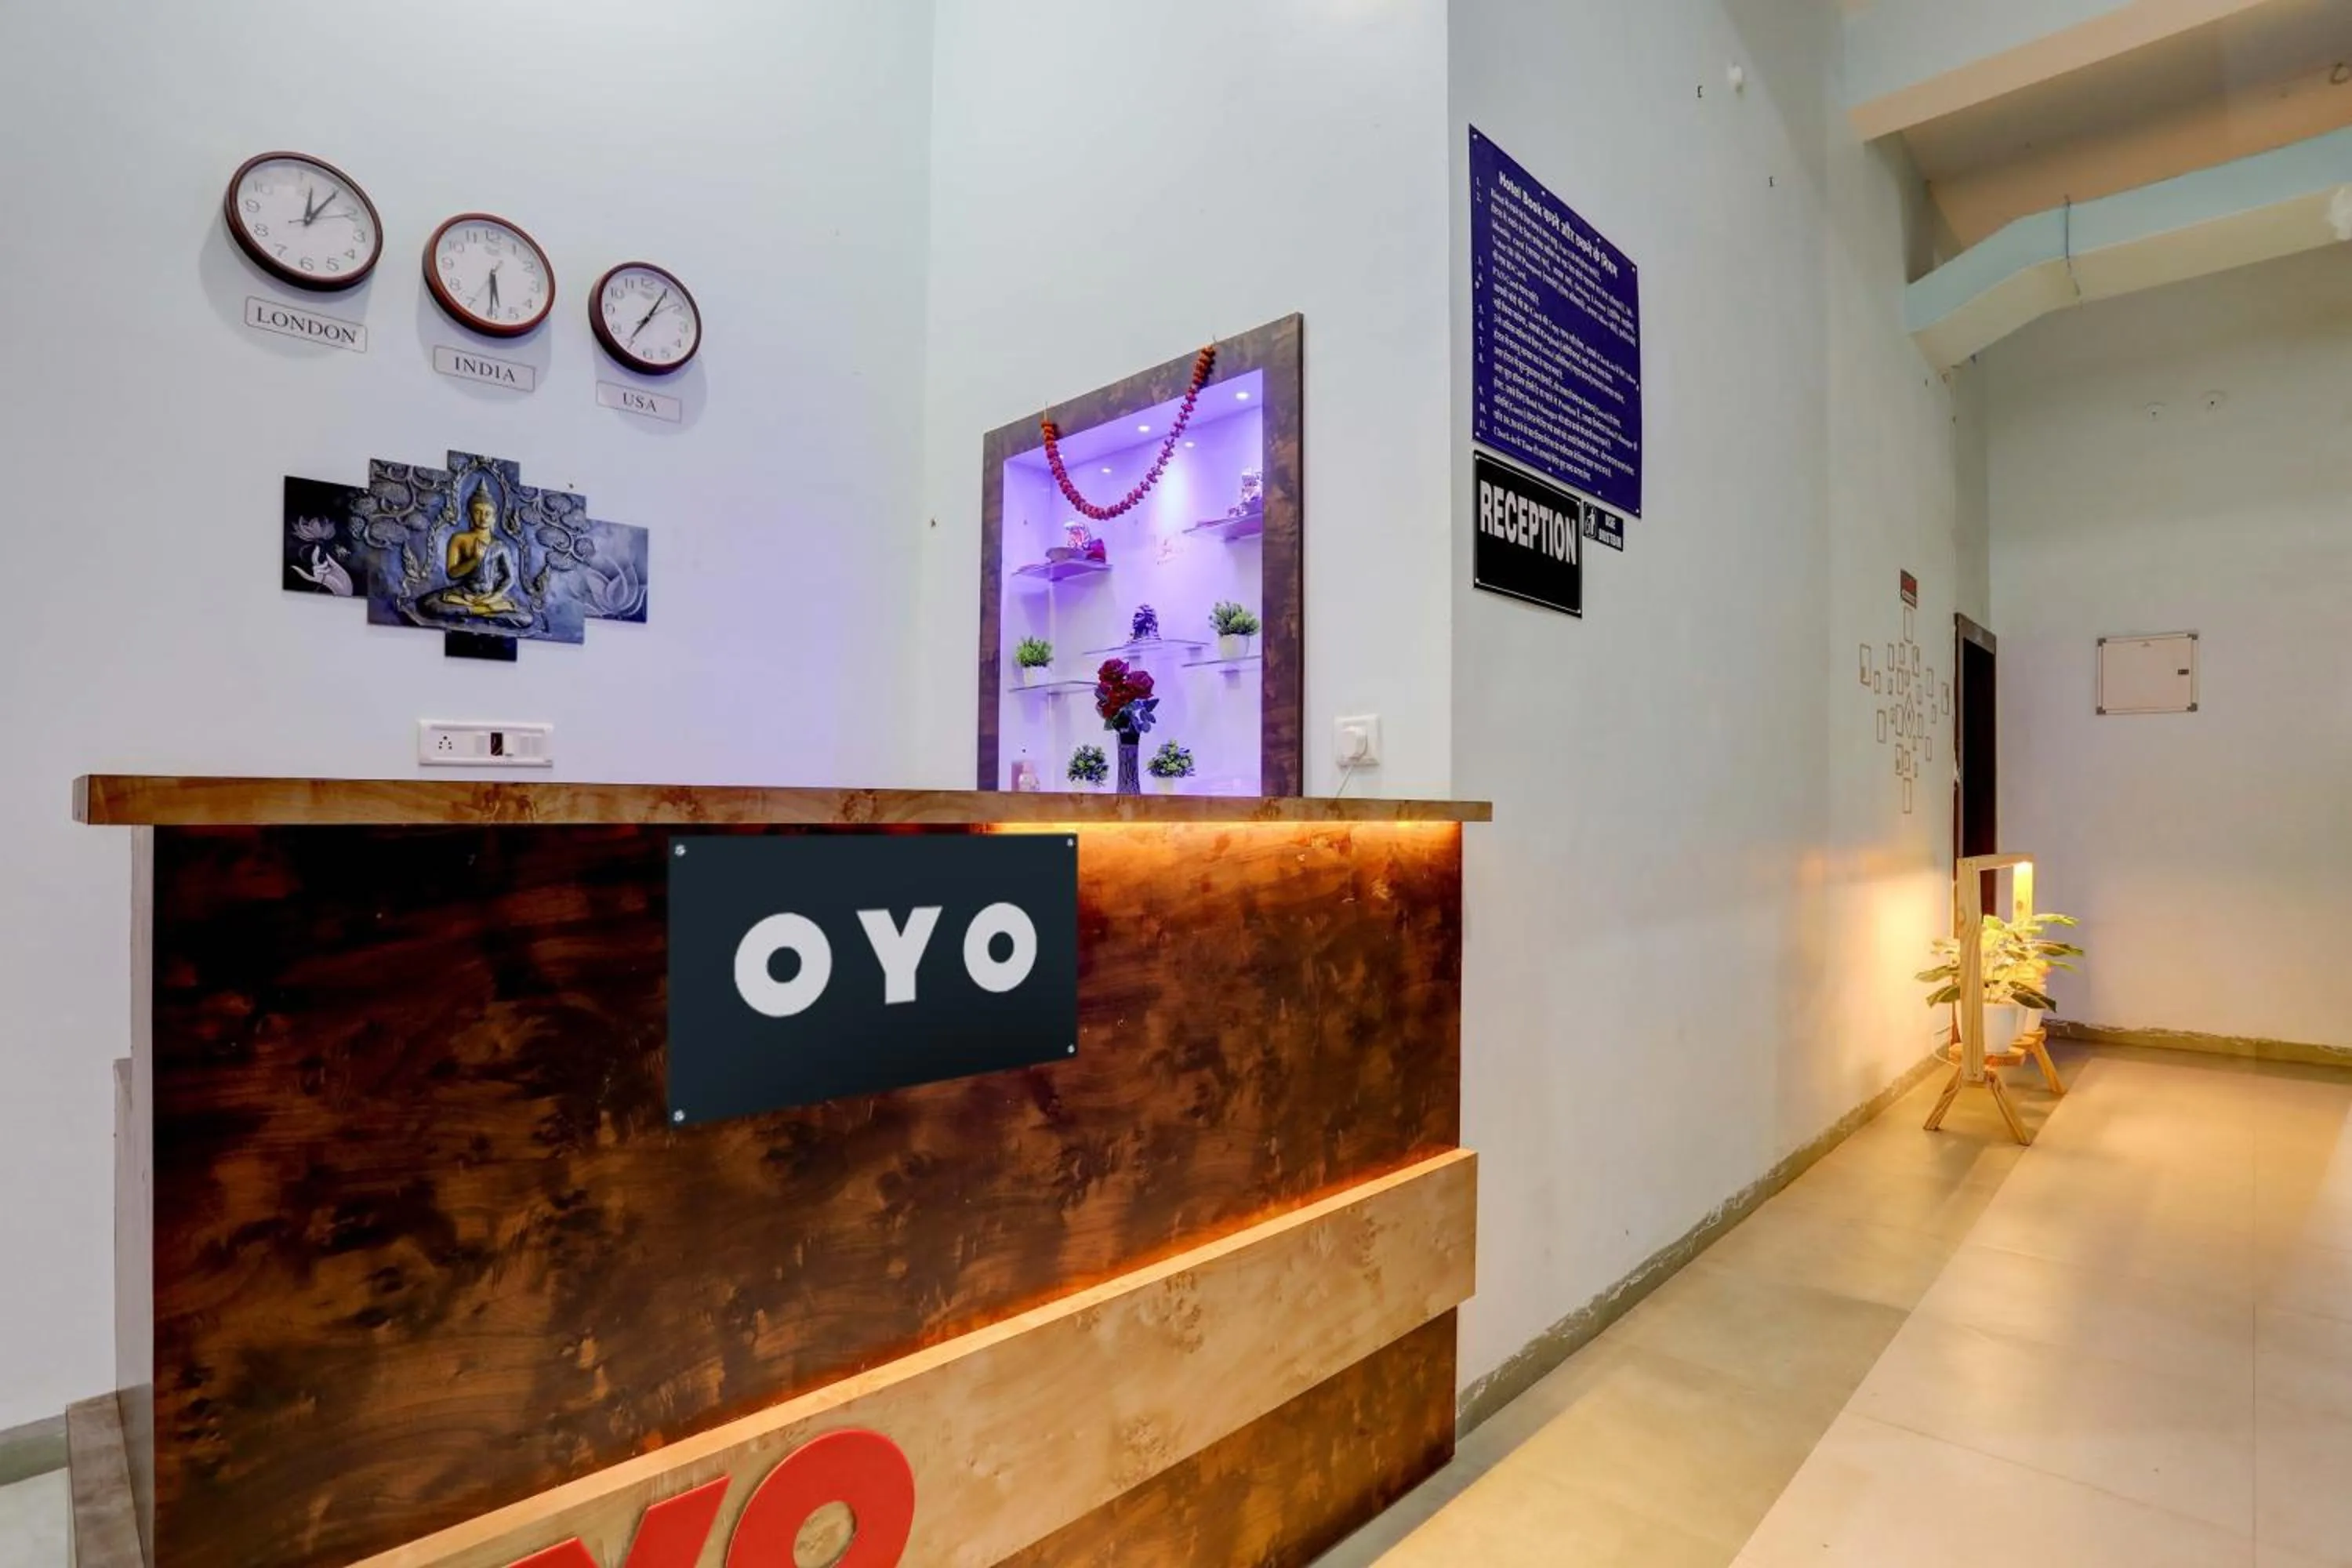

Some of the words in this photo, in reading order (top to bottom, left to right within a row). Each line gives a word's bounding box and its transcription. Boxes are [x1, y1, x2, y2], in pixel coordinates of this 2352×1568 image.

[246, 199, 260, 213] 9
[254, 223, 268, 237] 8
[354, 229, 365, 243] 3
[466, 230, 477, 243] 11
[274, 243, 289, 256] 7
[449, 241, 464, 253] 10
[343, 249, 355, 260] 4
[299, 257, 314, 271] 6
[326, 256, 339, 271] 5
[442, 257, 454, 270] 9
[625, 278, 634, 289] 11
[612, 288, 625, 299] 10
[524, 299, 532, 309] 4
[256, 307, 357, 344] LONDON
[673, 339, 681, 348] 4
[455, 356, 515, 383] INDIA
[622, 392, 658, 412] USA
[1480, 480, 1576, 564] RECEPTION
[734, 902, 1037, 1017] OYO
